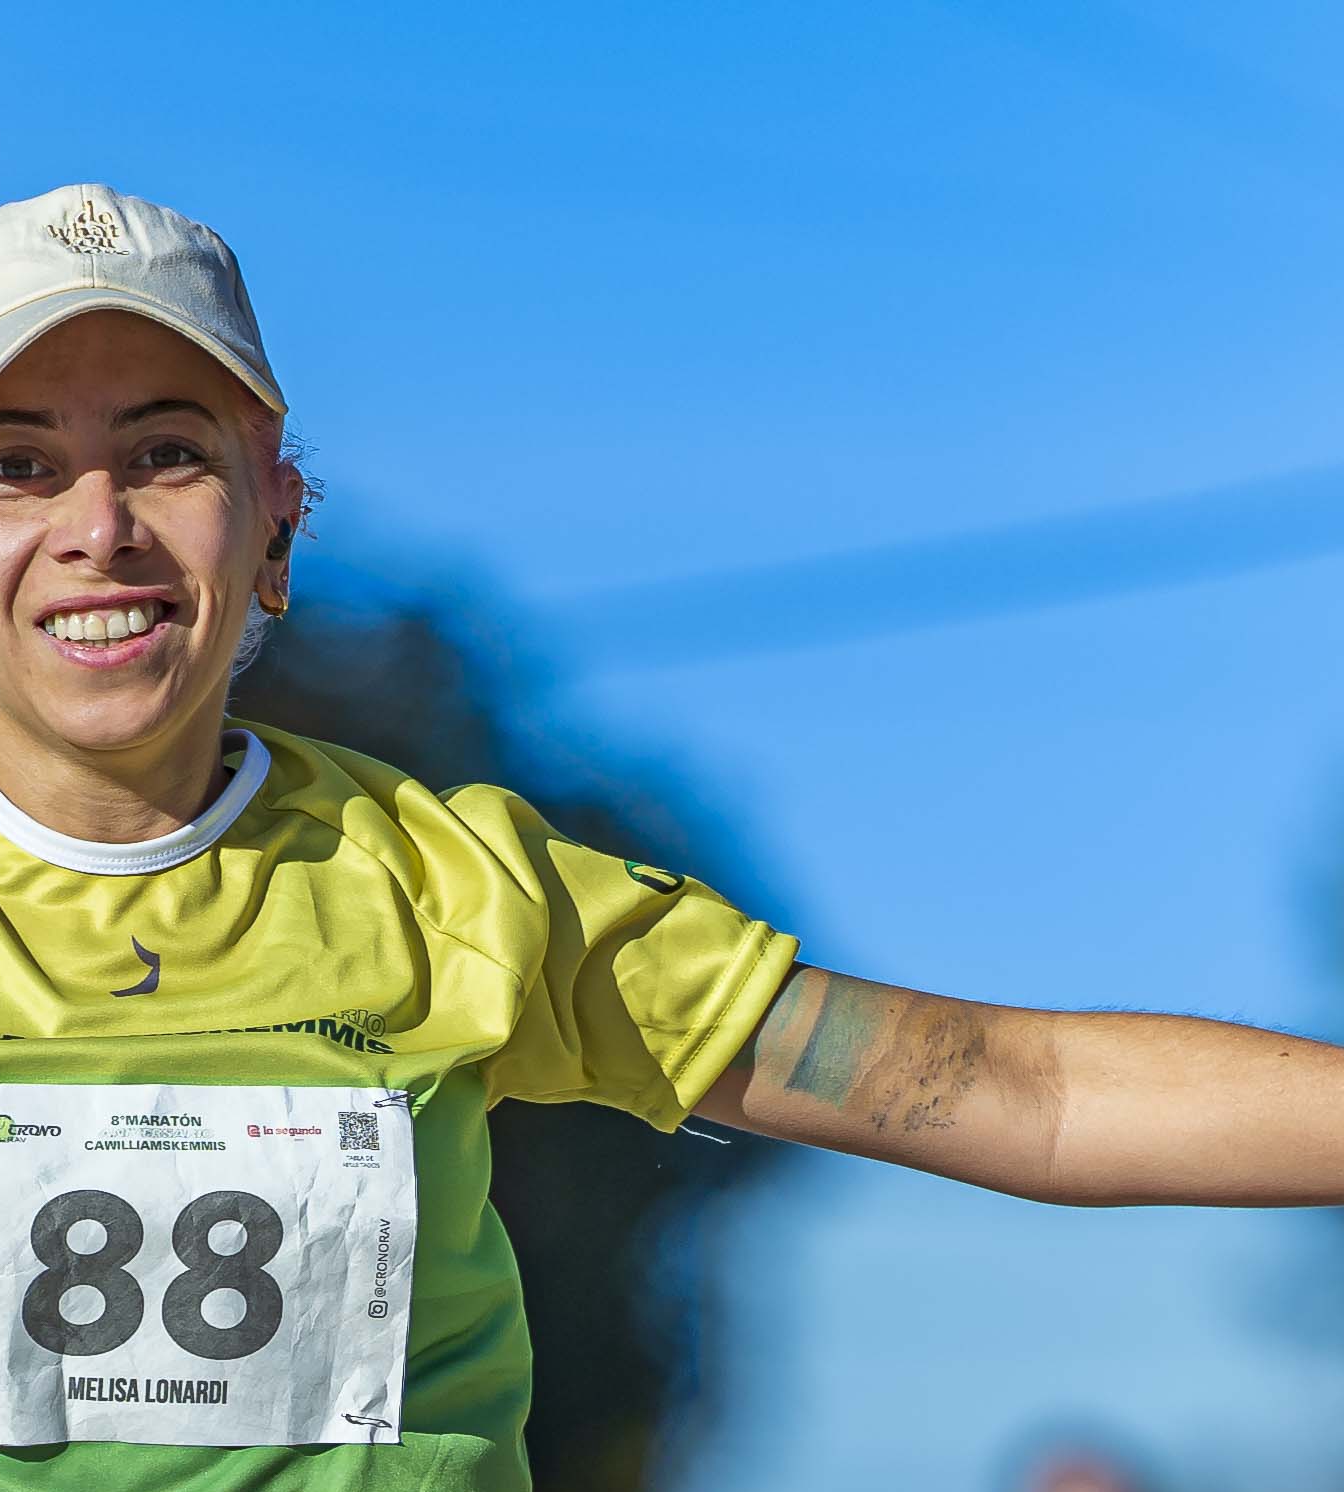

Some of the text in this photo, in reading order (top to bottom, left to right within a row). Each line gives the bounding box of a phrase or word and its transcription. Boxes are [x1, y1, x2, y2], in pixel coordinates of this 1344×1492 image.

[84, 1140, 226, 1151] CAWILLIAMSKEMMIS
[22, 1189, 284, 1361] 88
[374, 1218, 391, 1298] @CRONORAV
[67, 1376, 228, 1404] MELISA LONARDI
